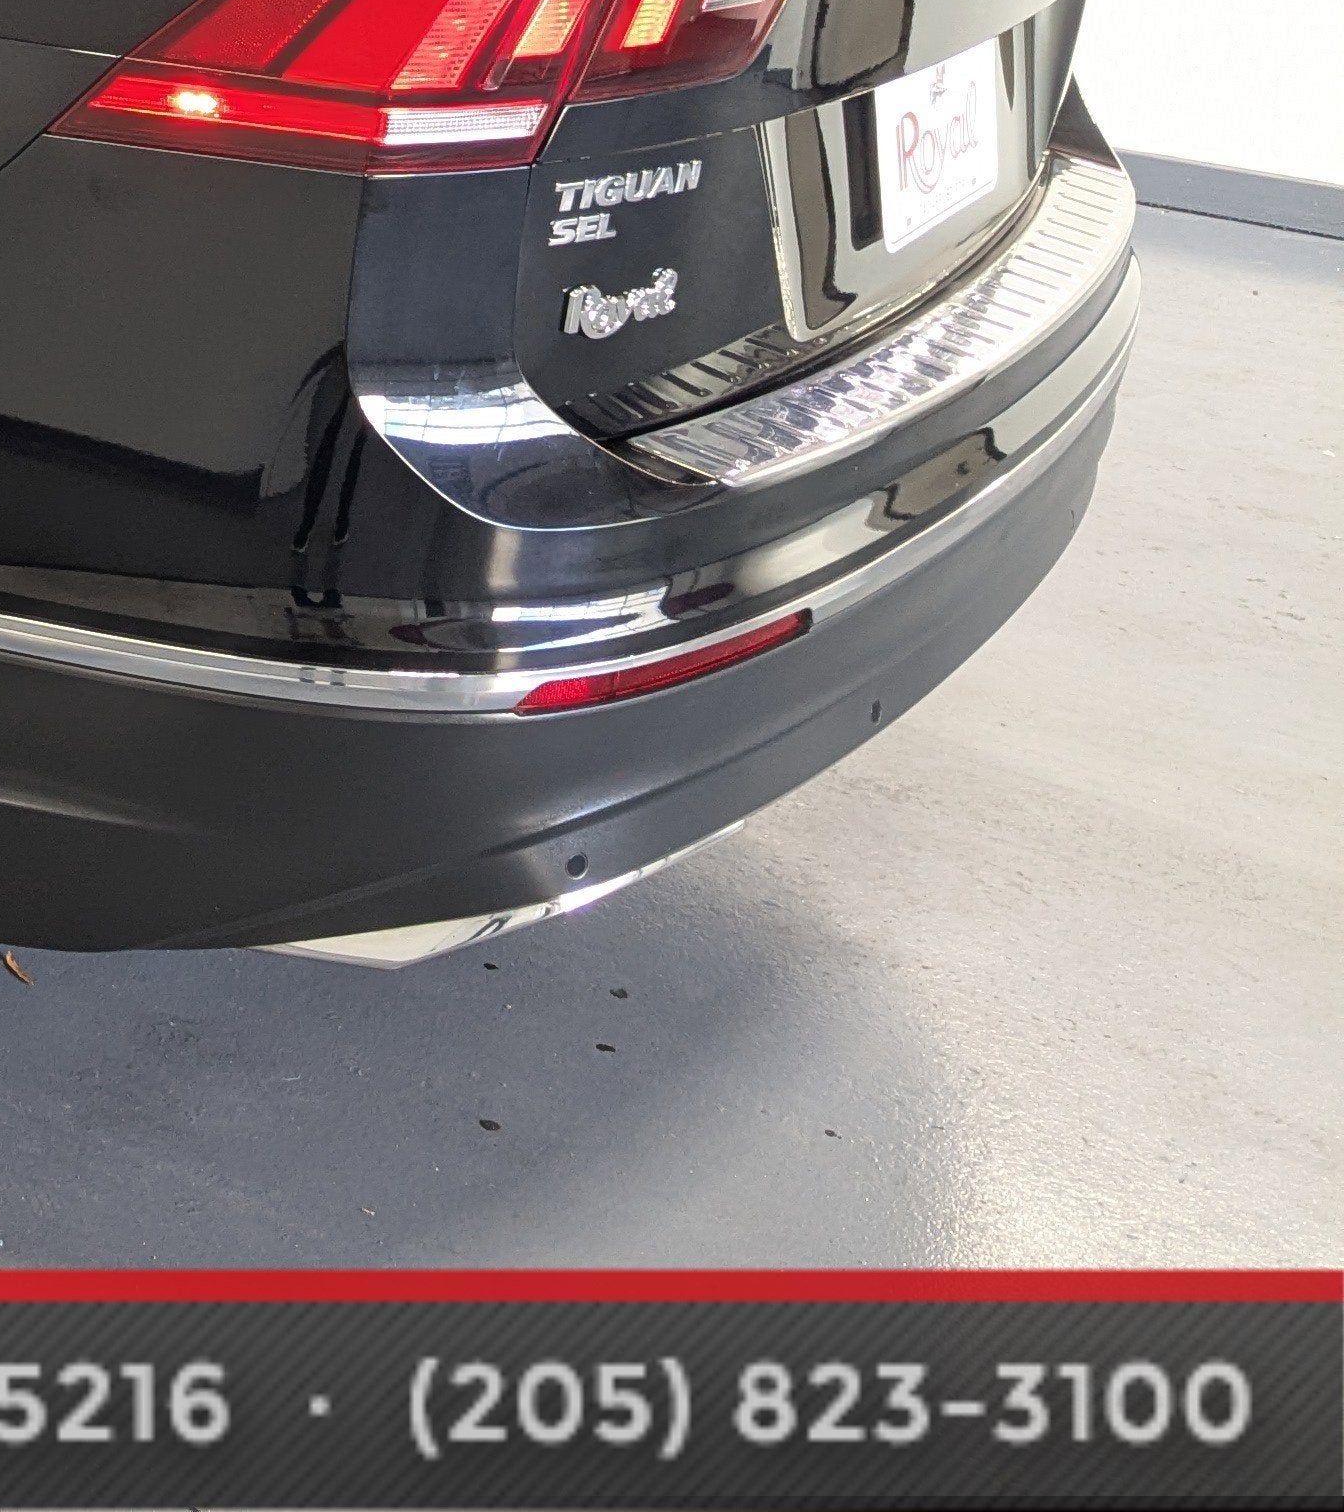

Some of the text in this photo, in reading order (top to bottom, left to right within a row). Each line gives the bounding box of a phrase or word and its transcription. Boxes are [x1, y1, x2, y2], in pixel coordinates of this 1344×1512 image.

[894, 80, 980, 195] Royal
[554, 159, 702, 212] TIGUAN
[548, 212, 617, 247] SEL
